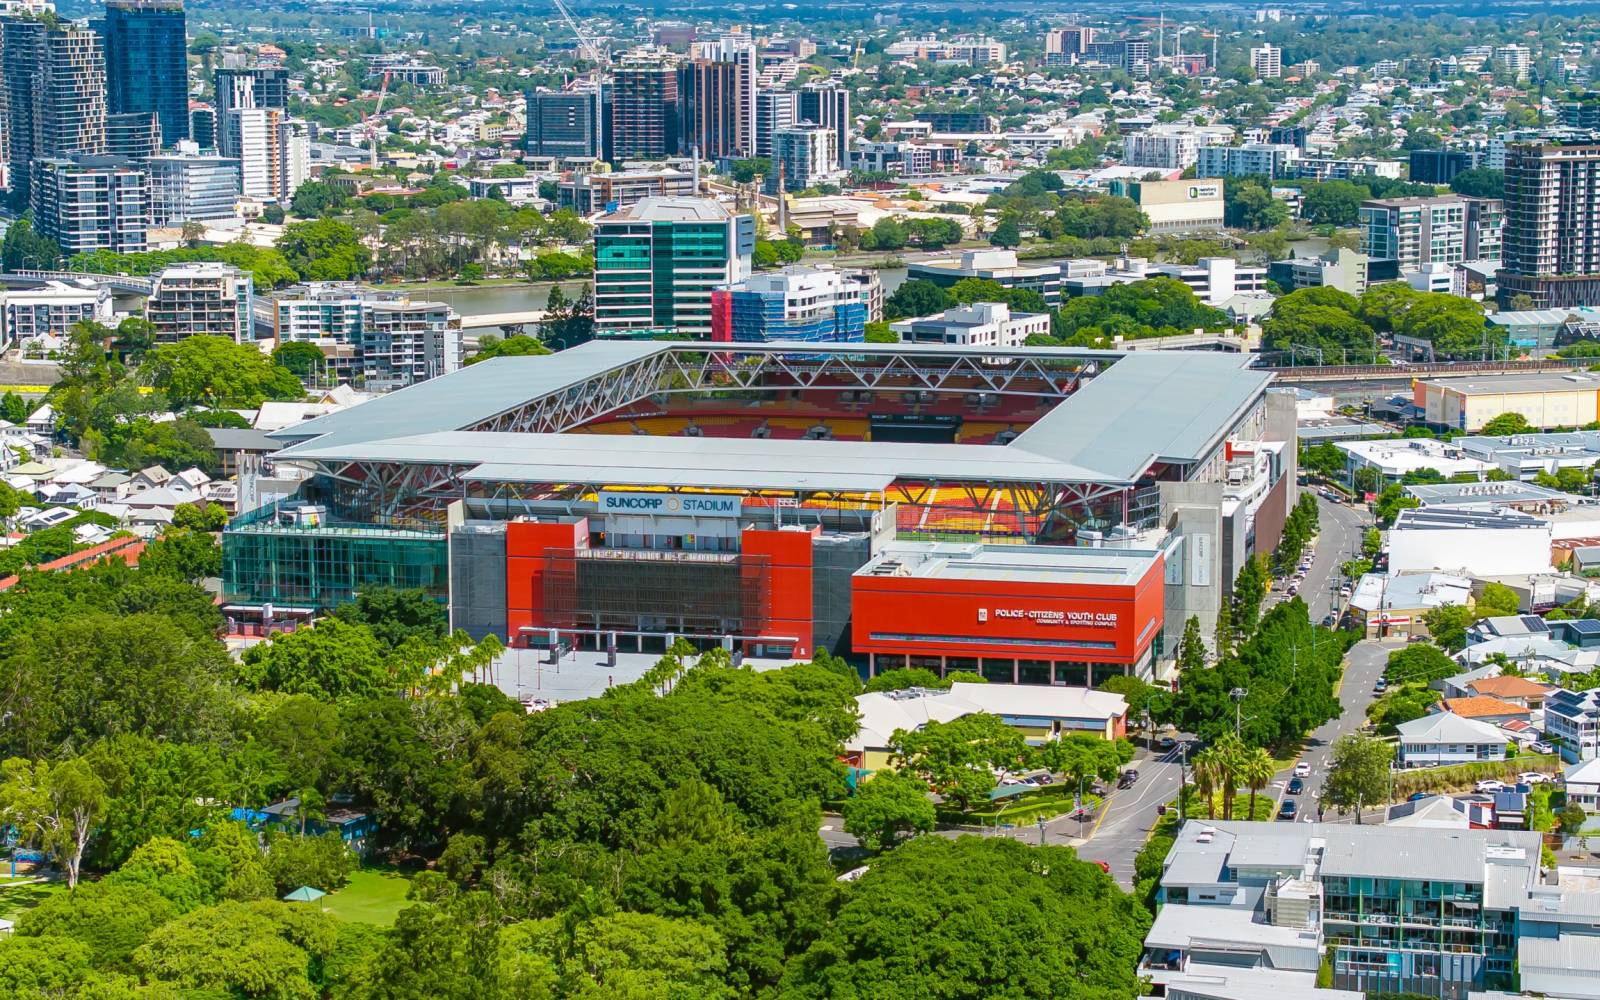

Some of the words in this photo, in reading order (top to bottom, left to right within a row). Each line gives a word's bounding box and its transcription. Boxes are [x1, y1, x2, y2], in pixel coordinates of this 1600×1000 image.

[606, 497, 662, 509] SUNCORP
[683, 500, 734, 511] STADIUM
[1067, 612, 1093, 620] YOUTH
[1095, 613, 1117, 621] CLUB
